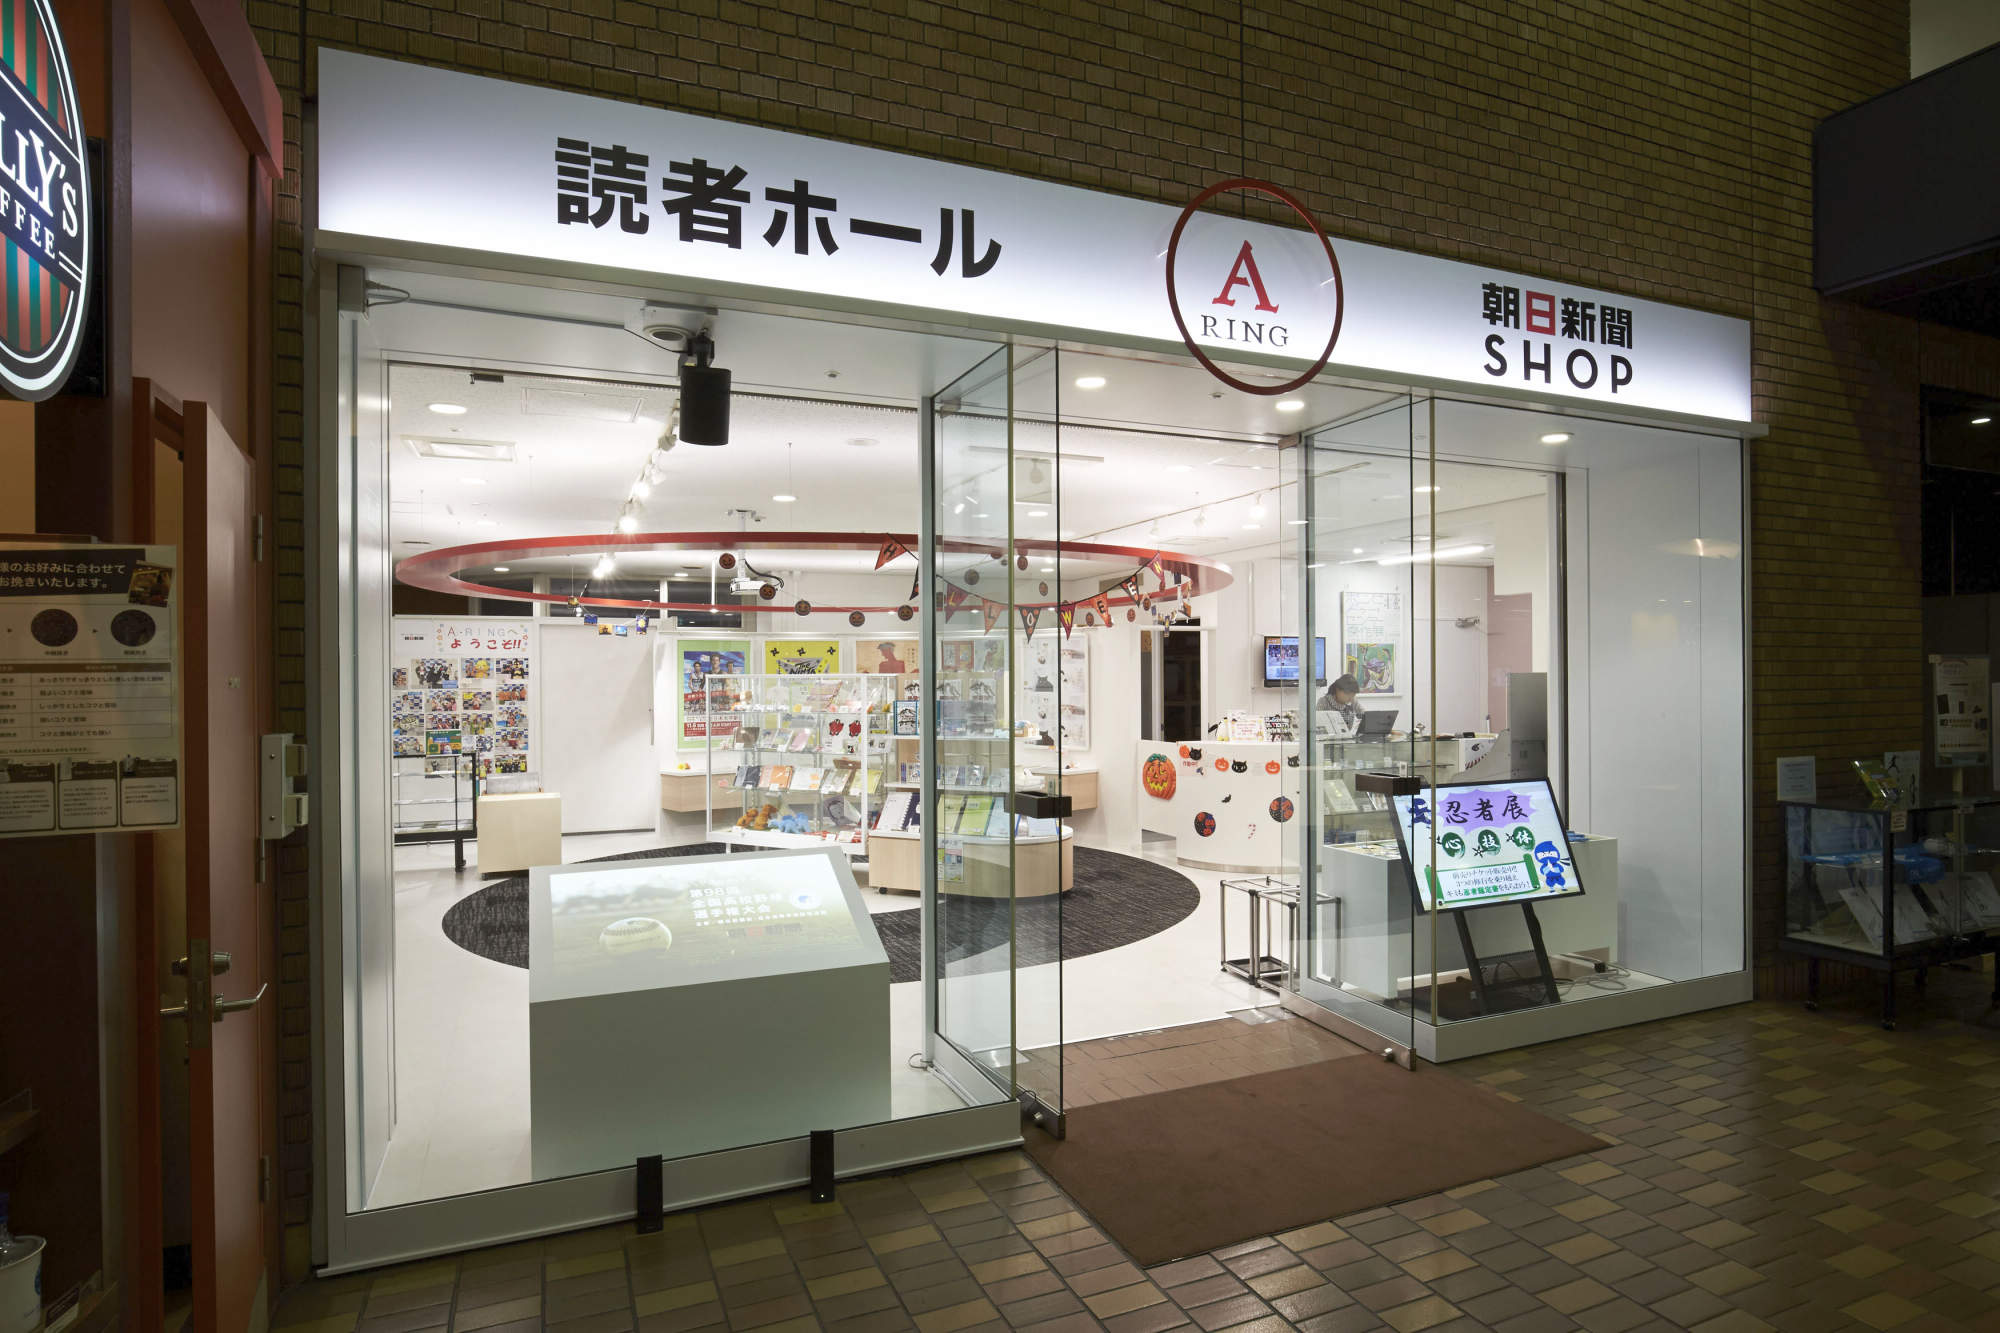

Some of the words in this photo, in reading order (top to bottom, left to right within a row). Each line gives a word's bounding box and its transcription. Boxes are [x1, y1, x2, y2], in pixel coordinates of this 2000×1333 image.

[555, 136, 1002, 278] 読者ホール
[1212, 240, 1279, 313] A
[1201, 315, 1289, 347] RING
[1482, 282, 1633, 350] 朝日新聞
[1484, 333, 1633, 394] SHOP
[1446, 795, 1528, 824] 忍者展
[1445, 839, 1461, 849] 心
[1482, 834, 1499, 848] 技
